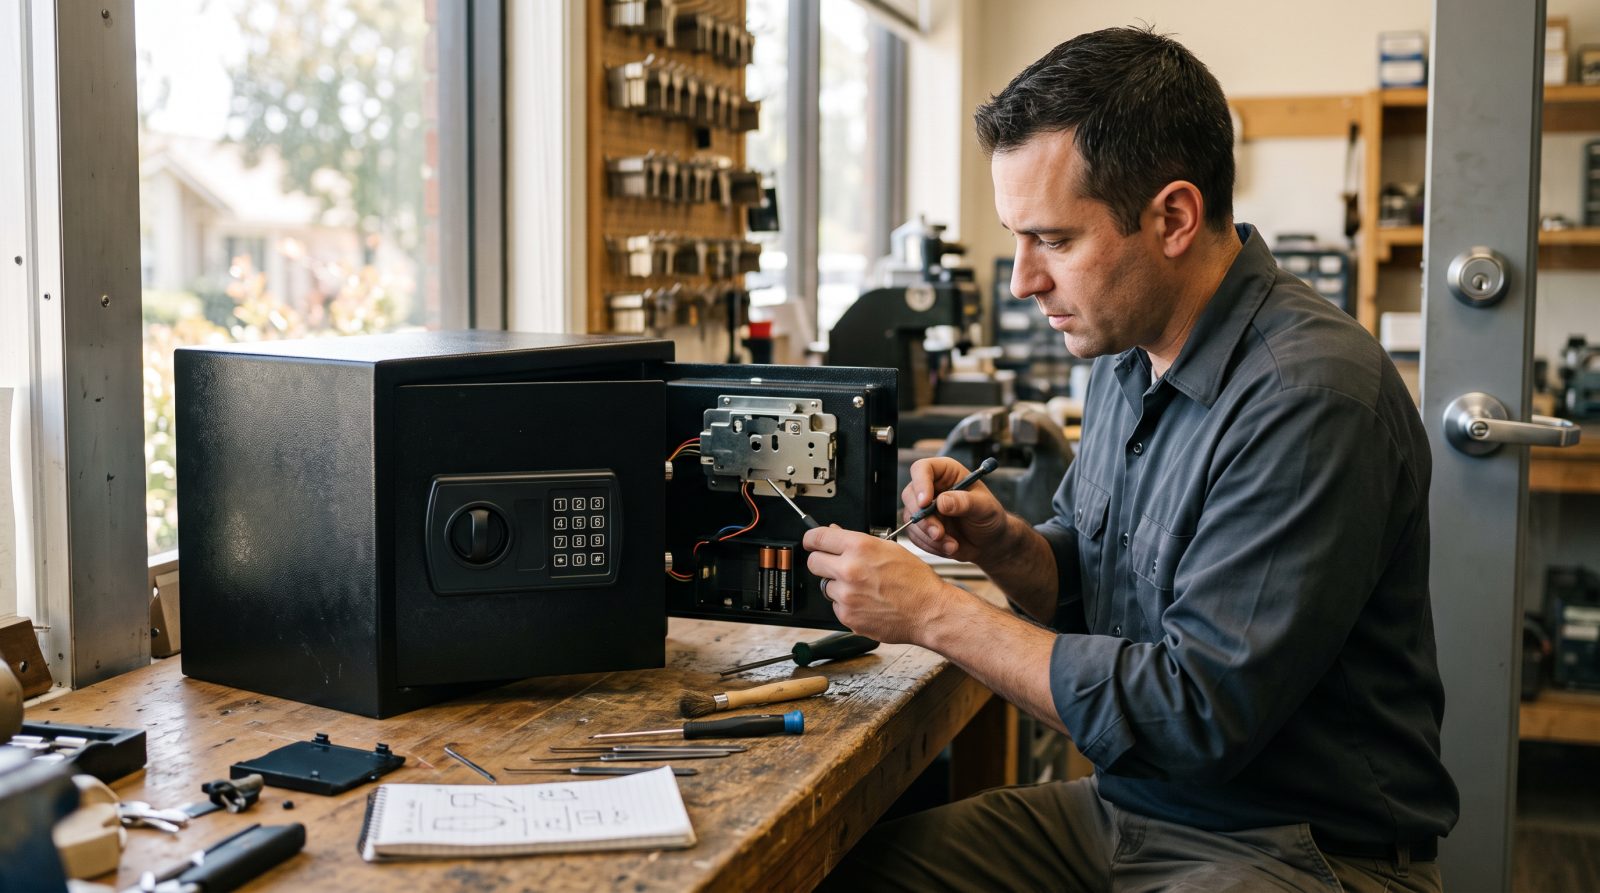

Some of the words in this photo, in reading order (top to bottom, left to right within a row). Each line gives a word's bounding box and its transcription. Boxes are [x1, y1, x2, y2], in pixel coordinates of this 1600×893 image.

[576, 499, 582, 508] 2
[594, 499, 601, 508] 3
[557, 518, 563, 527] 4
[576, 518, 582, 527] 5
[594, 517, 600, 526] 6
[557, 537, 564, 546] 7
[576, 537, 582, 545] 8
[594, 536, 601, 544] 9
[576, 555, 582, 564] 0
